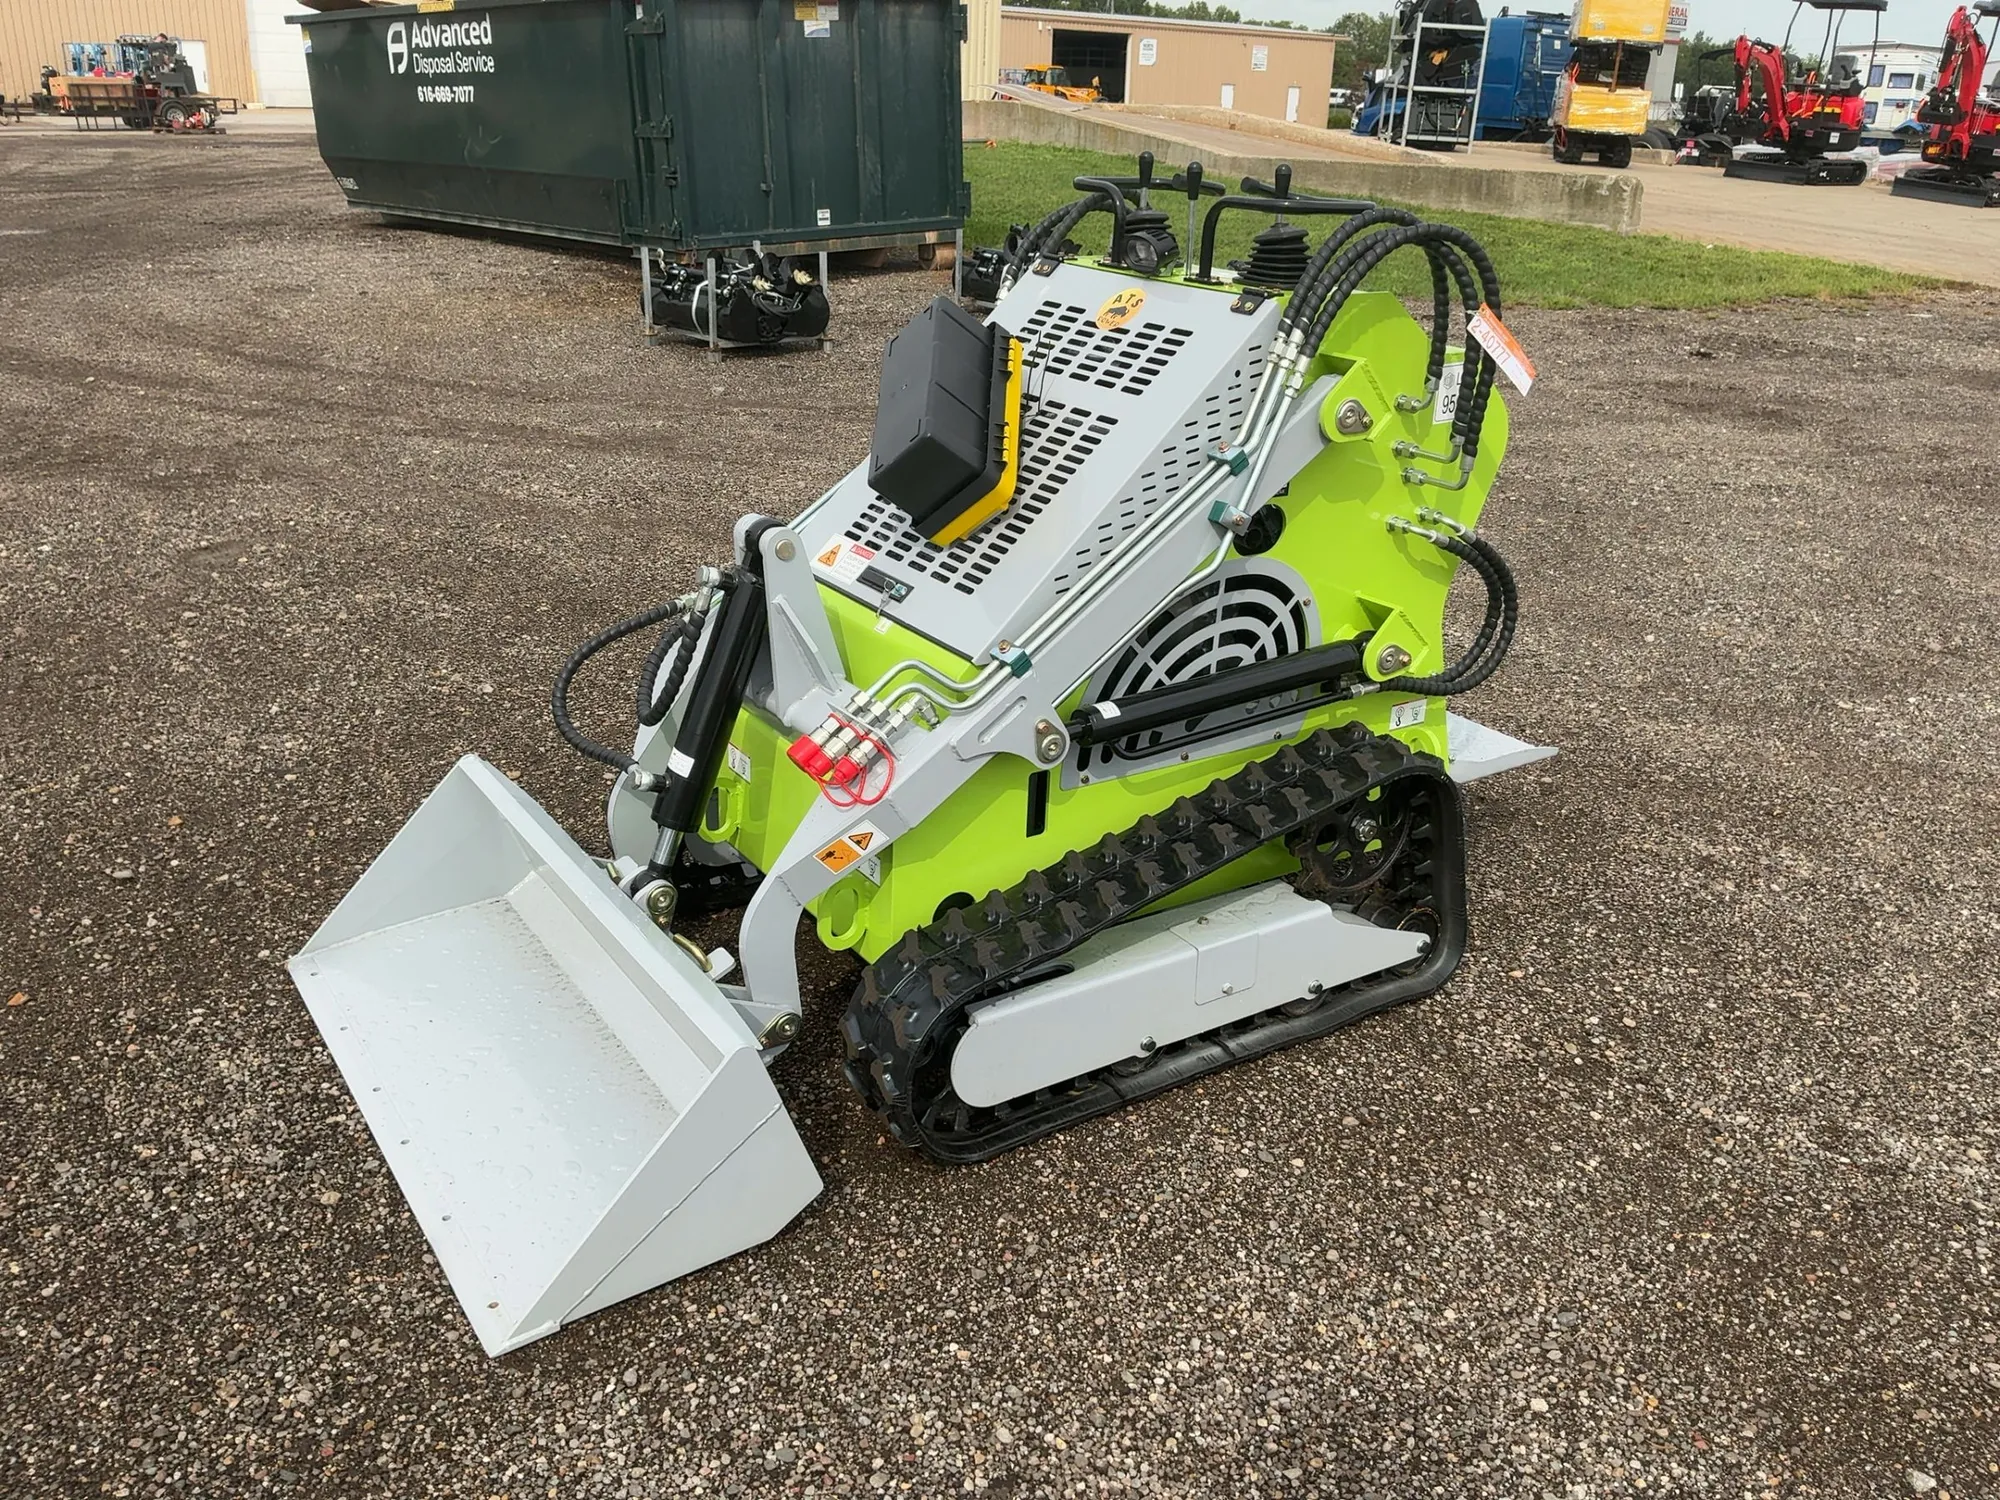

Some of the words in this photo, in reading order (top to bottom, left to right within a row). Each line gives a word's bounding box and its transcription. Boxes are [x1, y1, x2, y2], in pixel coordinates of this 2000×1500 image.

[411, 12, 493, 49] Advanced
[412, 51, 456, 79] Disposal
[455, 50, 495, 73] Service
[417, 85, 475, 103] 616-669-7077
[1471, 318, 1512, 365] 2-40777
[1441, 394, 1457, 415] 95
